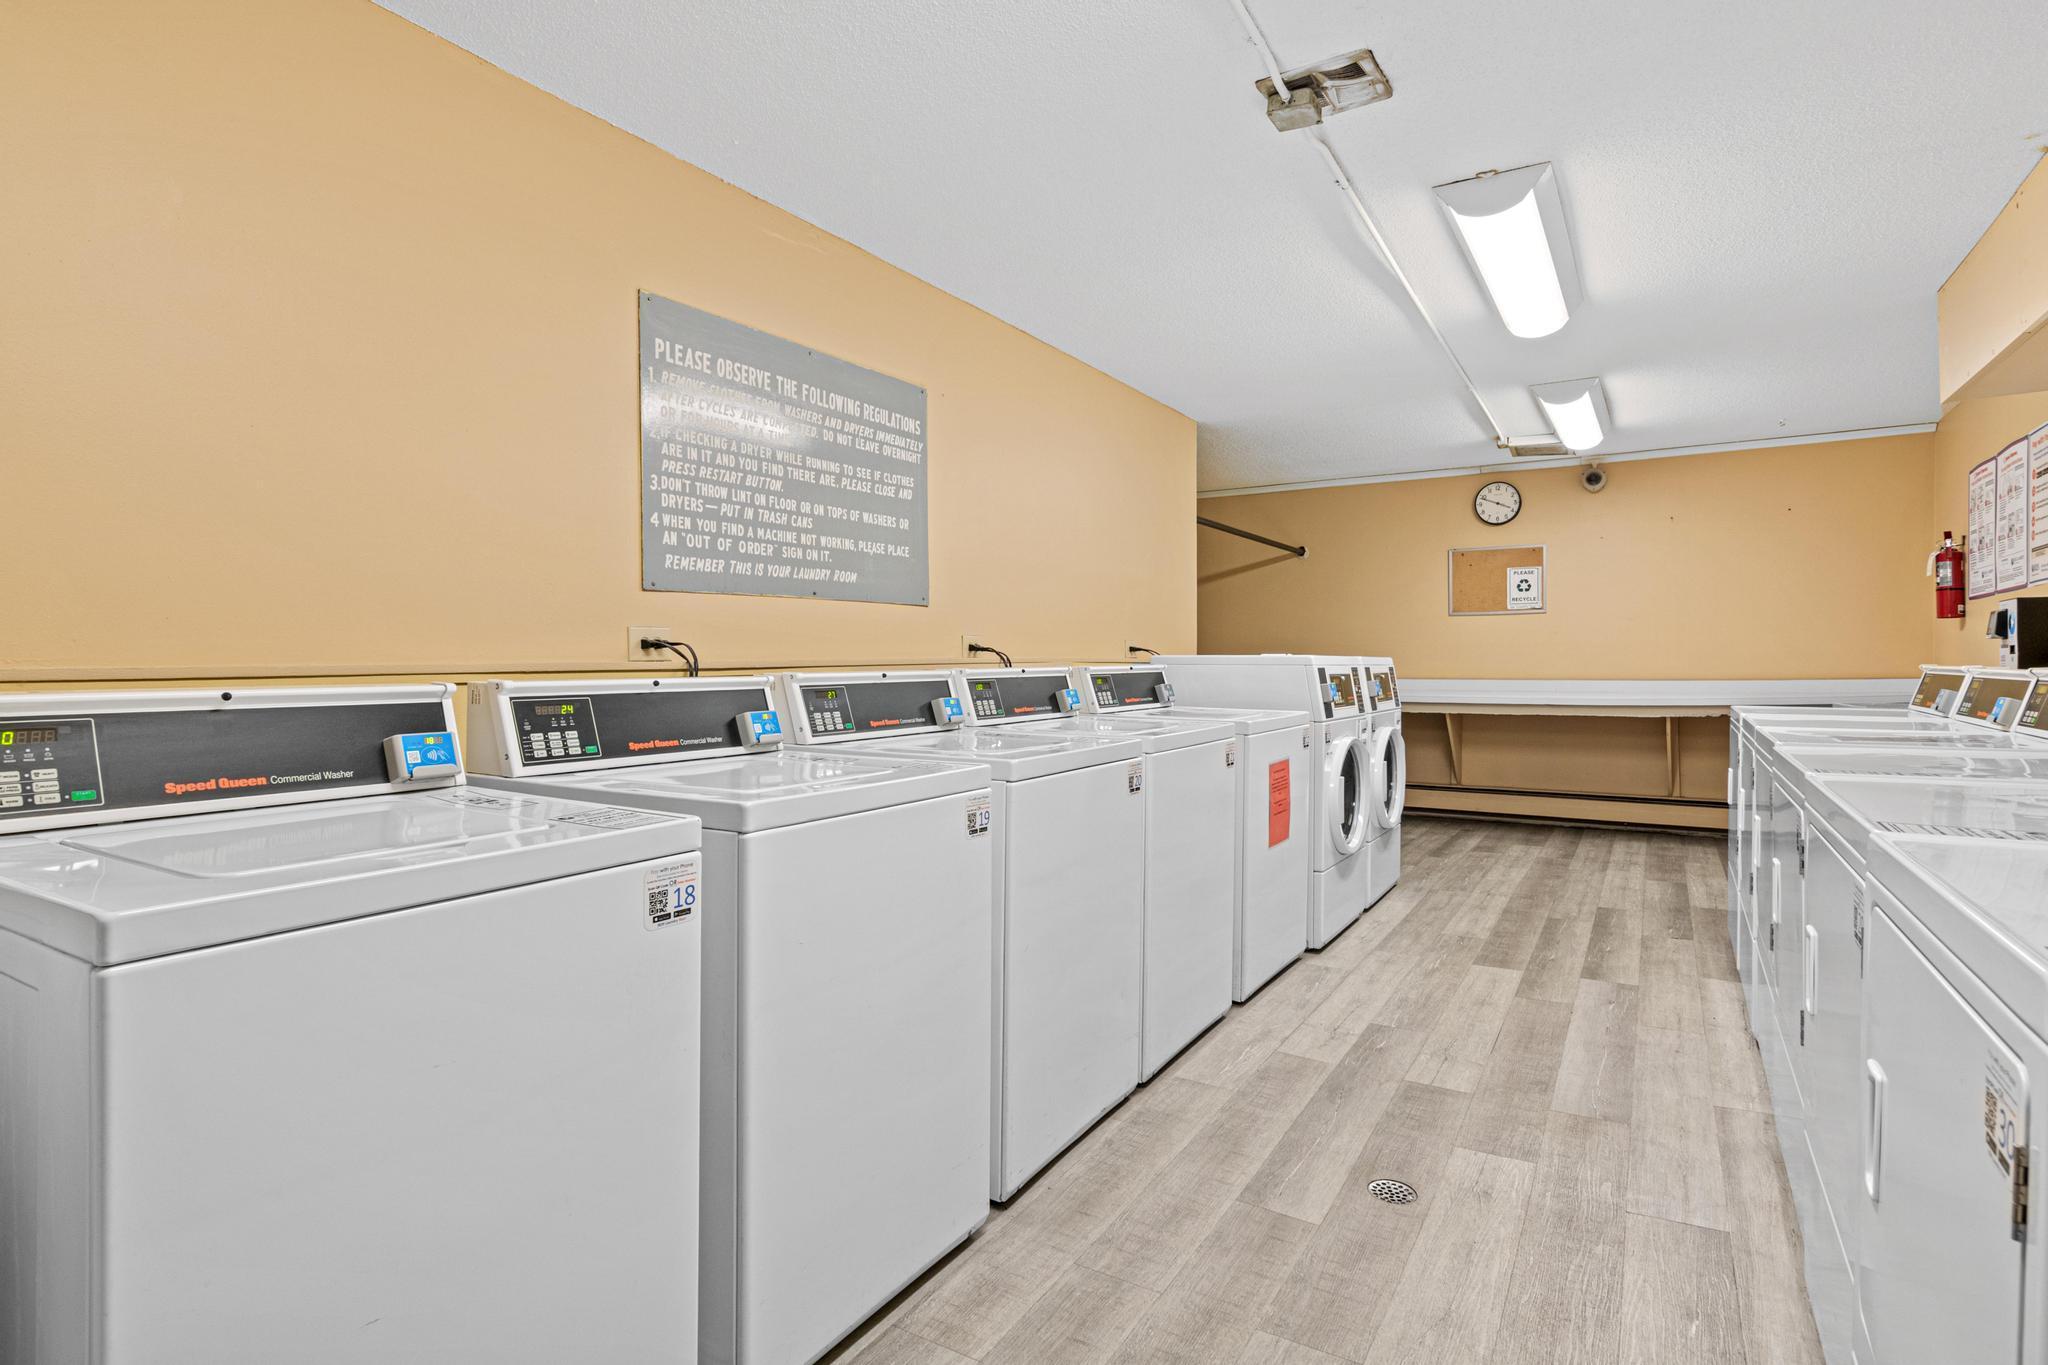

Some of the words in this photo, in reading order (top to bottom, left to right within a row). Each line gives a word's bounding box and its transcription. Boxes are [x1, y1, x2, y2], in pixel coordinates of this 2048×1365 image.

[655, 337, 711, 374] PLEASE
[716, 358, 771, 392] OBSERVE
[776, 375, 798, 400] THE
[802, 384, 860, 417] FOLLOWING
[863, 403, 920, 435] REGULATIONS
[661, 371, 705, 391] REMOVE
[784, 404, 823, 425] WASHERS
[824, 416, 842, 430] AND
[844, 421, 874, 439] DRYERS
[875, 430, 923, 452] IMMEDIATELY
[699, 398, 737, 418] CYCLES
[823, 430, 834, 442] DO
[837, 434, 853, 447] NOT
[855, 438, 880, 454] LEAVE
[882, 445, 921, 464] OVERNIGHT
[661, 442, 683, 458] ARE
[687, 446, 698, 461] IN
[701, 450, 712, 463] IT
[716, 453, 735, 468] AND
[739, 457, 758, 472] YOU
[762, 461, 784, 477] FIND
[787, 466, 816, 483] THERE
[841, 478, 871, 494] PLEASE
[874, 483, 895, 498] CLOSE
[898, 488, 913, 500] AND
[675, 429, 728, 450] CHECKING
[730, 440, 738, 453] A
[741, 442, 772, 459] DRYER
[776, 449, 802, 466] WHILE
[806, 456, 840, 473] RUNNING
[843, 464, 853, 476] TO
[856, 467, 871, 480] SEE
[874, 471, 881, 481] IF
[883, 473, 914, 487] CLOTHES
[661, 459, 697, 476] PRESS
[699, 466, 743, 485] RESTART
[745, 474, 784, 492] BUTTON.
[695, 481, 728, 499] THROW
[732, 488, 752, 504] LINT
[754, 493, 766, 507] ON
[769, 495, 797, 511] FLOOR
[800, 501, 811, 514] OR
[813, 503, 824, 516] ON
[827, 505, 847, 520] TOPS
[850, 509, 860, 522] OF
[862, 512, 896, 528] WASHERS
[899, 518, 909, 530] OR
[720, 503, 741, 518] PUT
[744, 507, 754, 520] IN
[758, 509, 787, 525] TRASH
[791, 515, 813, 529] CANS
[662, 513, 691, 530] WHEN
[697, 518, 717, 533] YOU
[721, 521, 744, 537] FIND
[747, 526, 754, 539] A
[757, 527, 797, 544] MACHINE
[800, 532, 816, 546] NOT
[858, 540, 885, 556] PLEASE
[887, 543, 910, 558] PLACE
[662, 530, 678, 546] AN
[681, 532, 711, 549] "OUT
[717, 537, 733, 552] OF
[738, 540, 778, 557] ORDER"
[782, 546, 803, 560] SIGN
[806, 549, 818, 562] ON
[820, 550, 832, 562] IT.
[664, 554, 725, 573] REMEMBER
[729, 560, 752, 575] THIS
[754, 562, 765, 577] IS
[767, 564, 791, 579] YOUR
[793, 566, 831, 581] LAUNDRY
[833, 569, 858, 584] ROOM
[561, 704, 574, 715] 24
[629, 740, 654, 751] Speed
[164, 778, 216, 795] Speed
[219, 776, 268, 789] Queen
[270, 771, 321, 784] Commercial
[322, 769, 354, 780] Washer
[979, 810, 990, 827] 19
[674, 884, 696, 909] 18
[1999, 1109, 2015, 1160] 30
